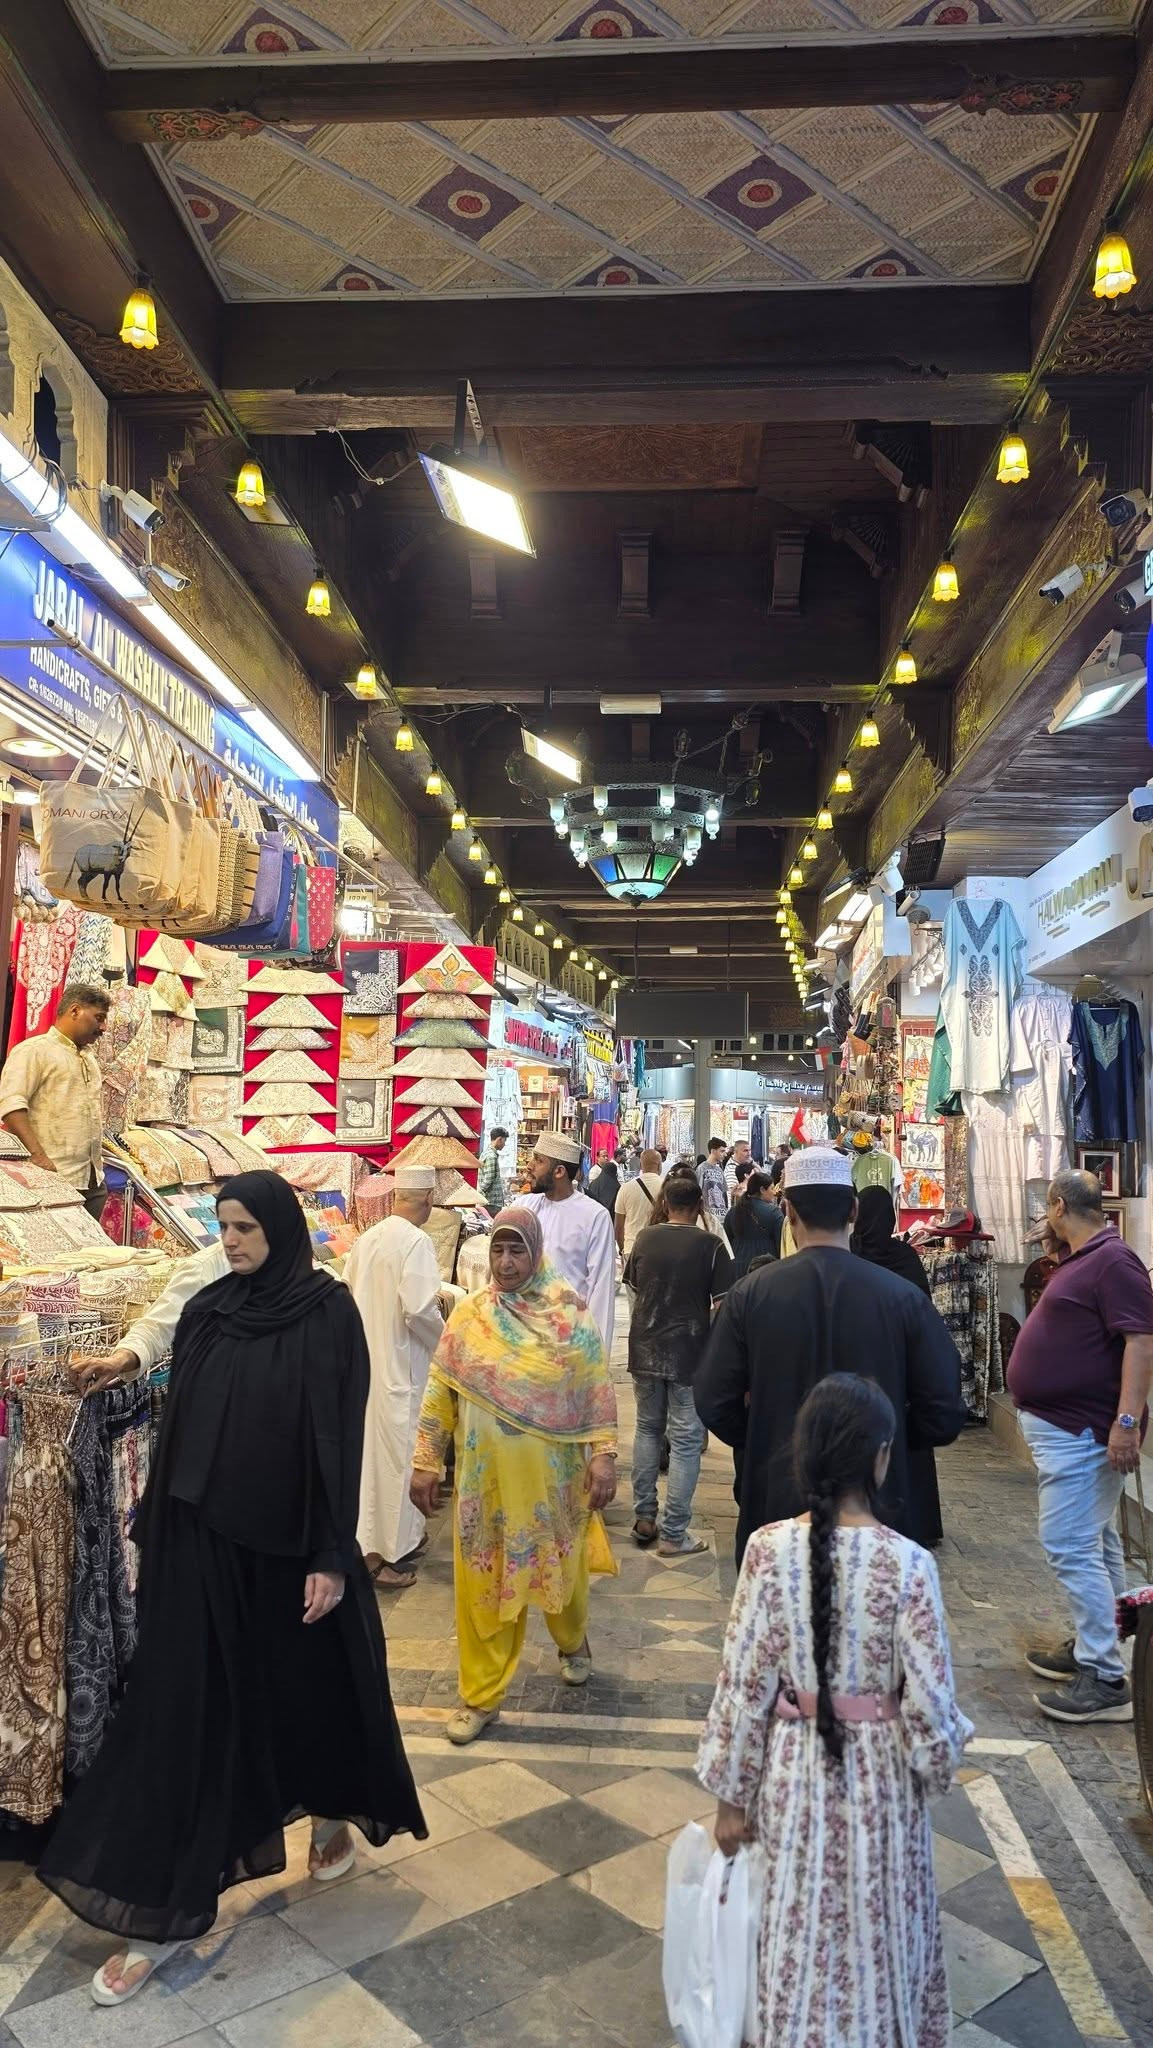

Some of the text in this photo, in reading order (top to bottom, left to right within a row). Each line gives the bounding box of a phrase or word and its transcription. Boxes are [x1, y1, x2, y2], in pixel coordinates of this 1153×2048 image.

[30, 644, 92, 708] HANDICRAFTS,
[91, 612, 112, 667] AL
[167, 673, 216, 752] TRADING
[43, 808, 127, 820] OMANI ORYX
